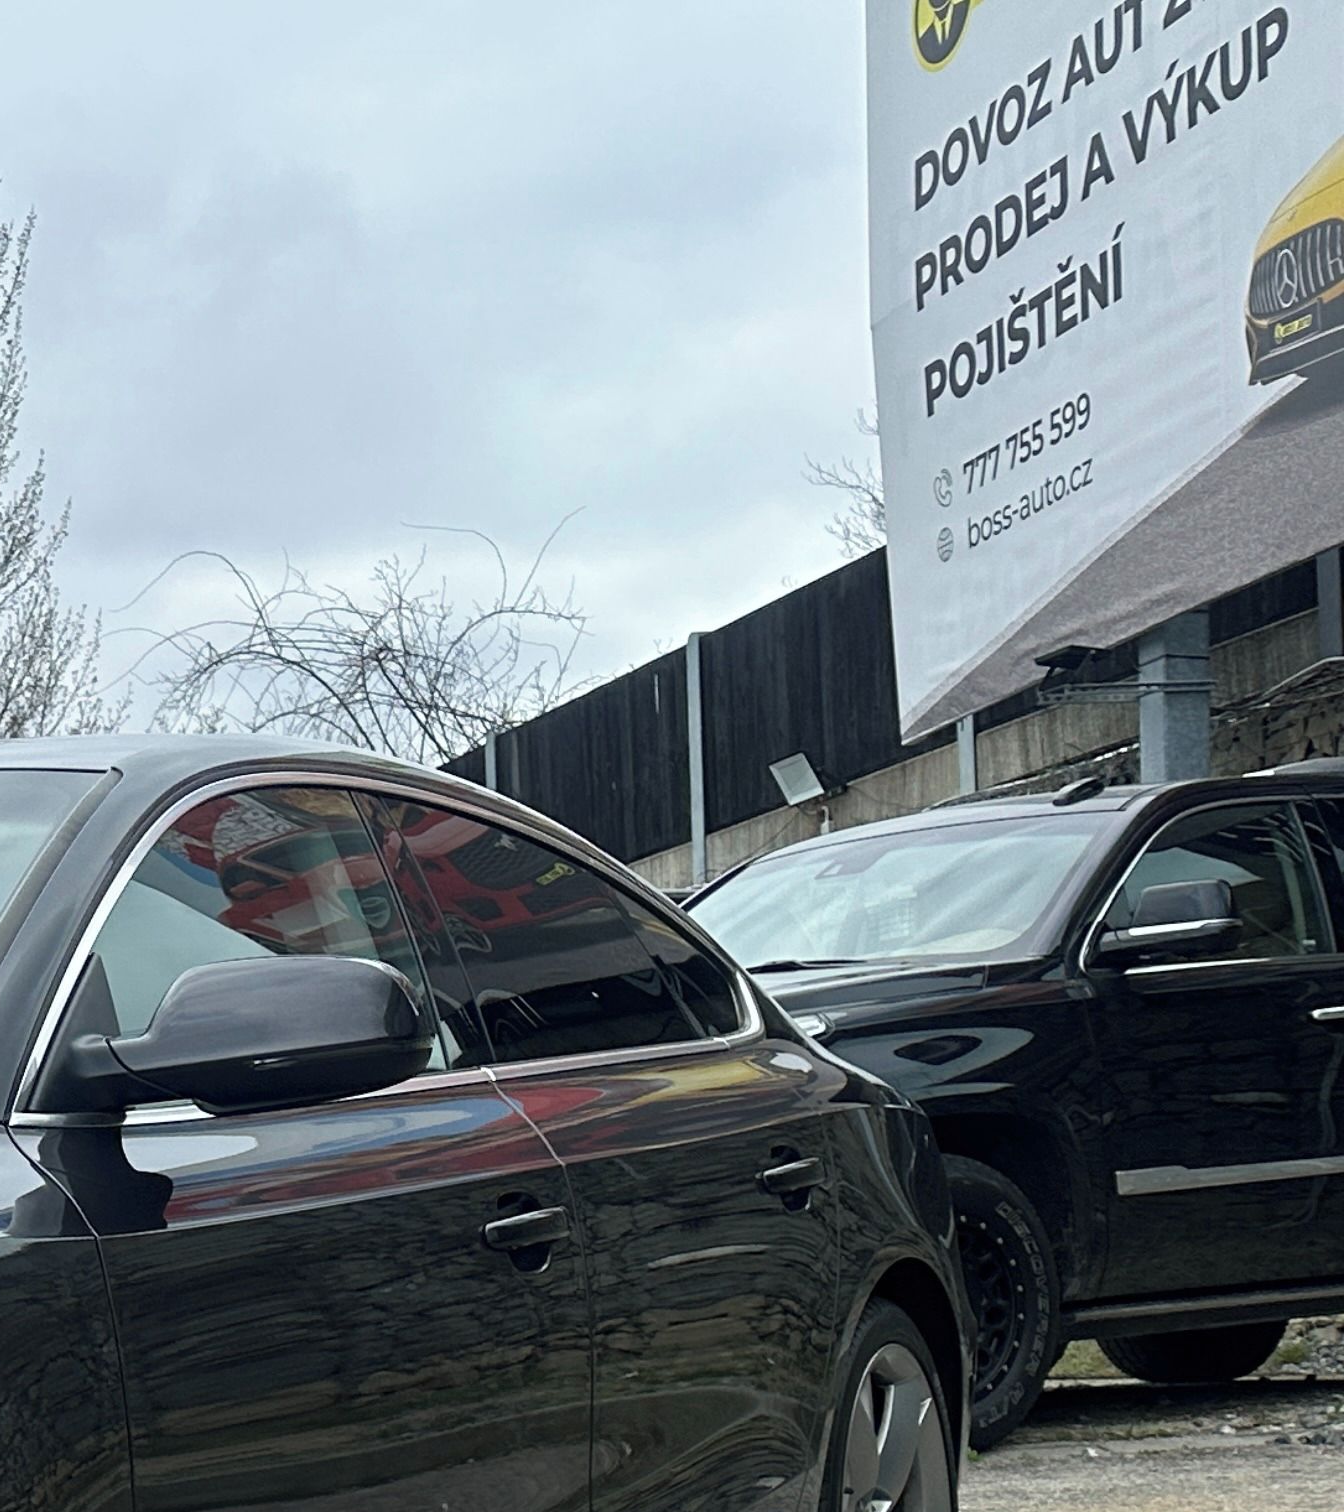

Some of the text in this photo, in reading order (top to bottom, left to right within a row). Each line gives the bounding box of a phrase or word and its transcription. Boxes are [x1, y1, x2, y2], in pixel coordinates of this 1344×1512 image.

[914, 0, 1143, 212] DOVOZ AUT
[915, 6, 1289, 312] PRODEJ A VÝKUP
[924, 220, 1126, 418] POJIŠTĚNÍ
[963, 393, 1091, 494] 777 755 599
[968, 458, 1094, 549] boss-auto.cz
